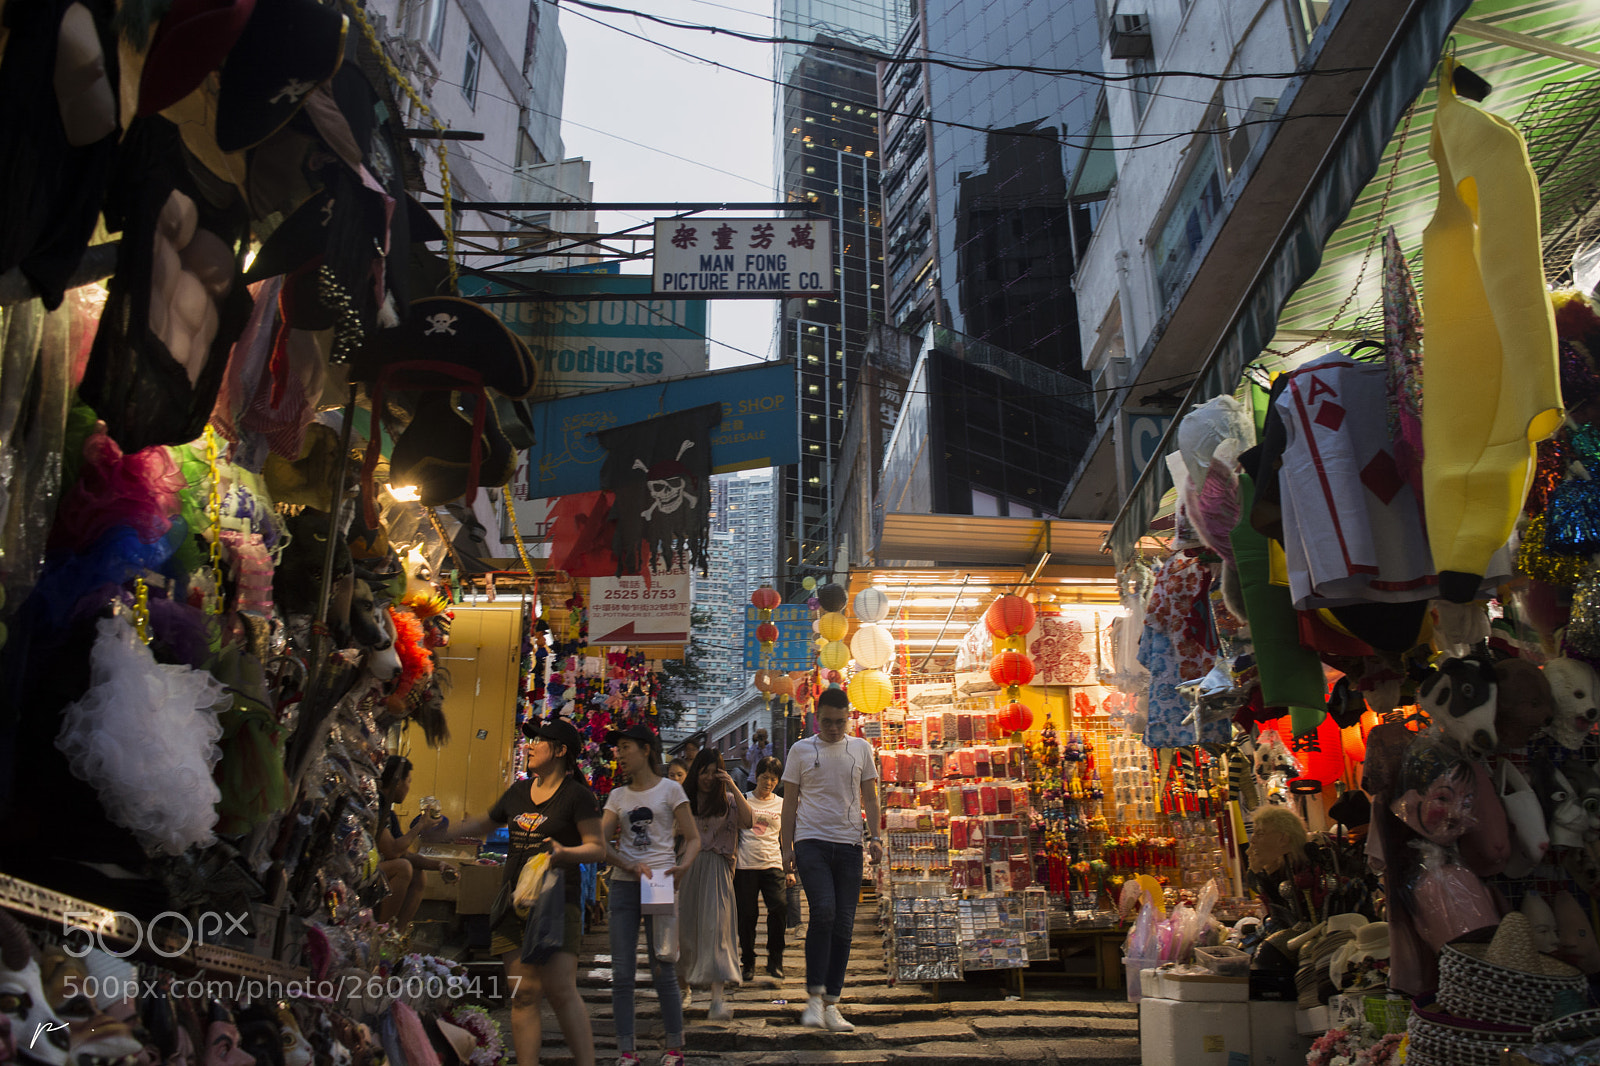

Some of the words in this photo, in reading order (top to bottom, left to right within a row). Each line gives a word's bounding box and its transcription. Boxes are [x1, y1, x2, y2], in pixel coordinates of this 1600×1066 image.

[699, 254, 734, 272] MAN
[745, 254, 787, 272] FONG
[663, 272, 729, 290] PICTURE
[737, 272, 791, 290] FRAME
[799, 272, 824, 290] CO.
[1307, 375, 1338, 406] A
[738, 395, 785, 414] SHOP
[711, 430, 767, 446] HOLESALE
[604, 589, 639, 600] 2525
[643, 589, 677, 600] 8753
